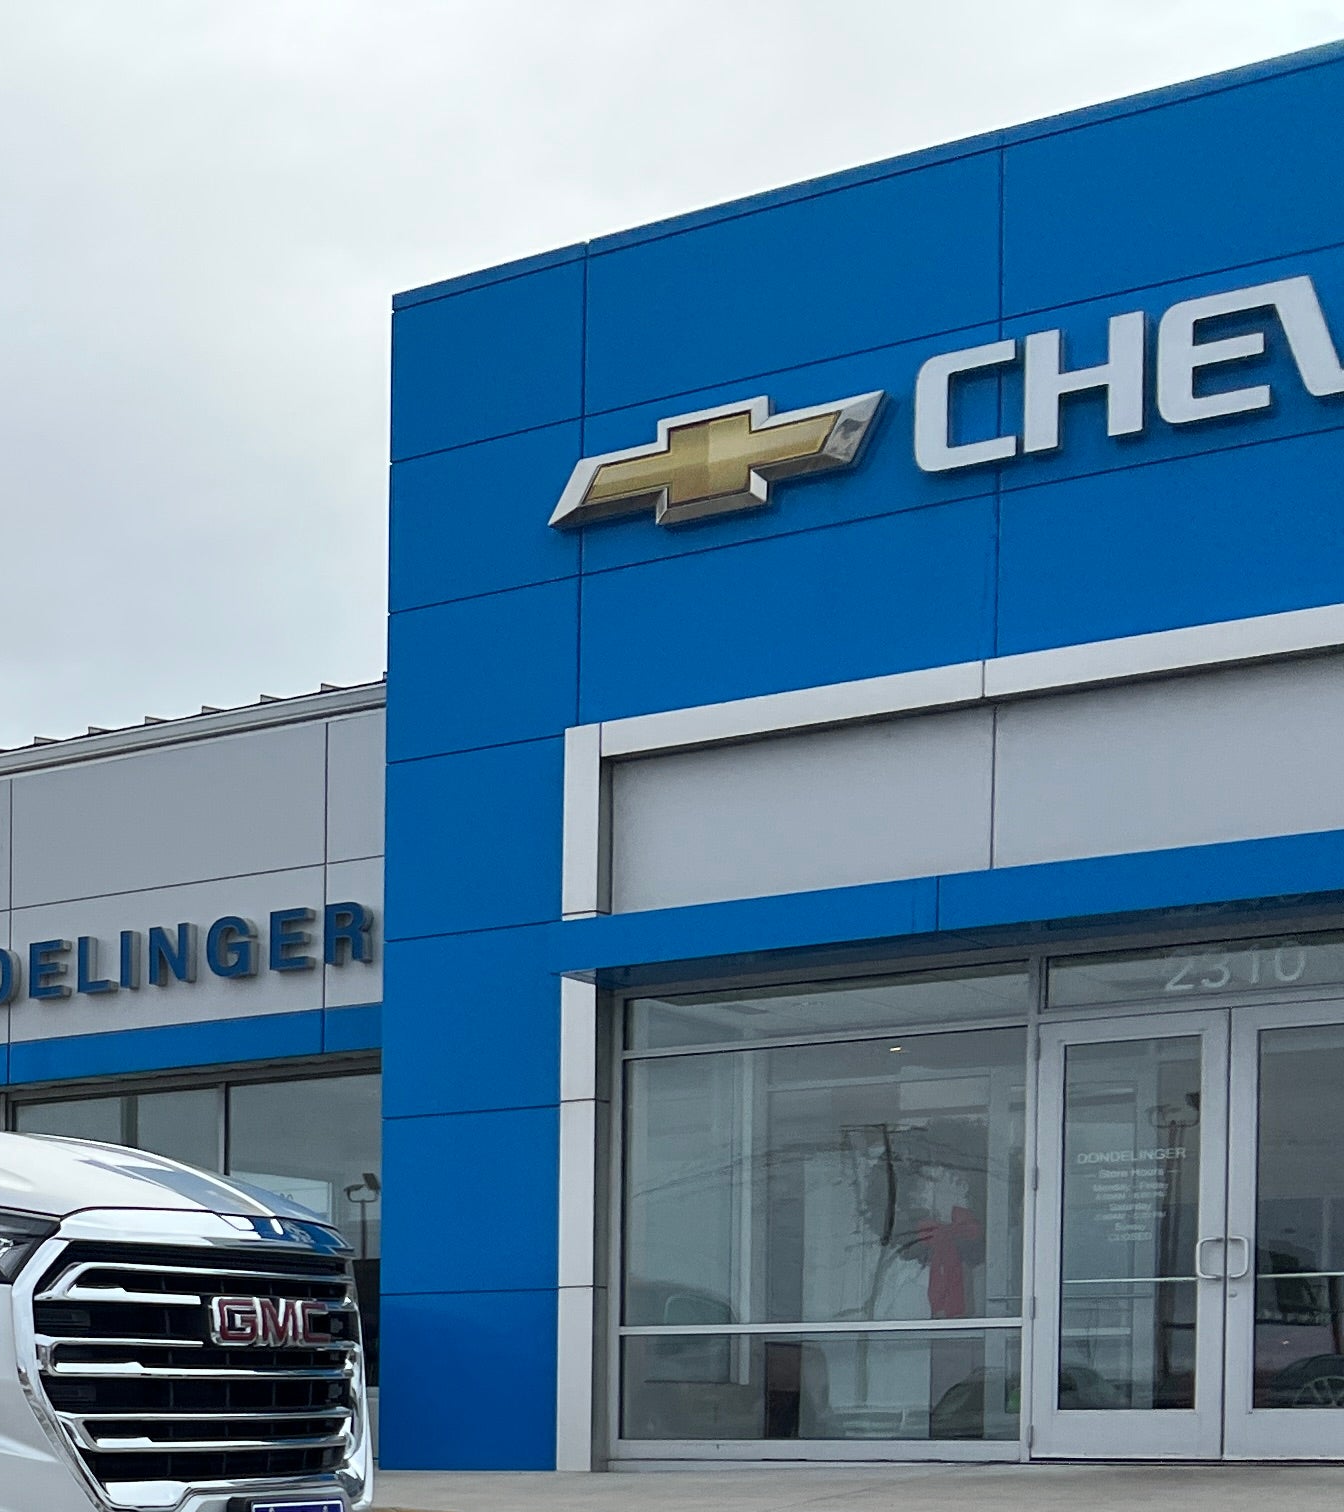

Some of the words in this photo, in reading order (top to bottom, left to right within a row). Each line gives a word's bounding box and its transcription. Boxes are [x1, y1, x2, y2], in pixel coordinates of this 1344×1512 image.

[1164, 940, 1307, 992] 2310
[1077, 1147, 1186, 1164] DONDELINGER
[210, 1296, 332, 1348] GMC
